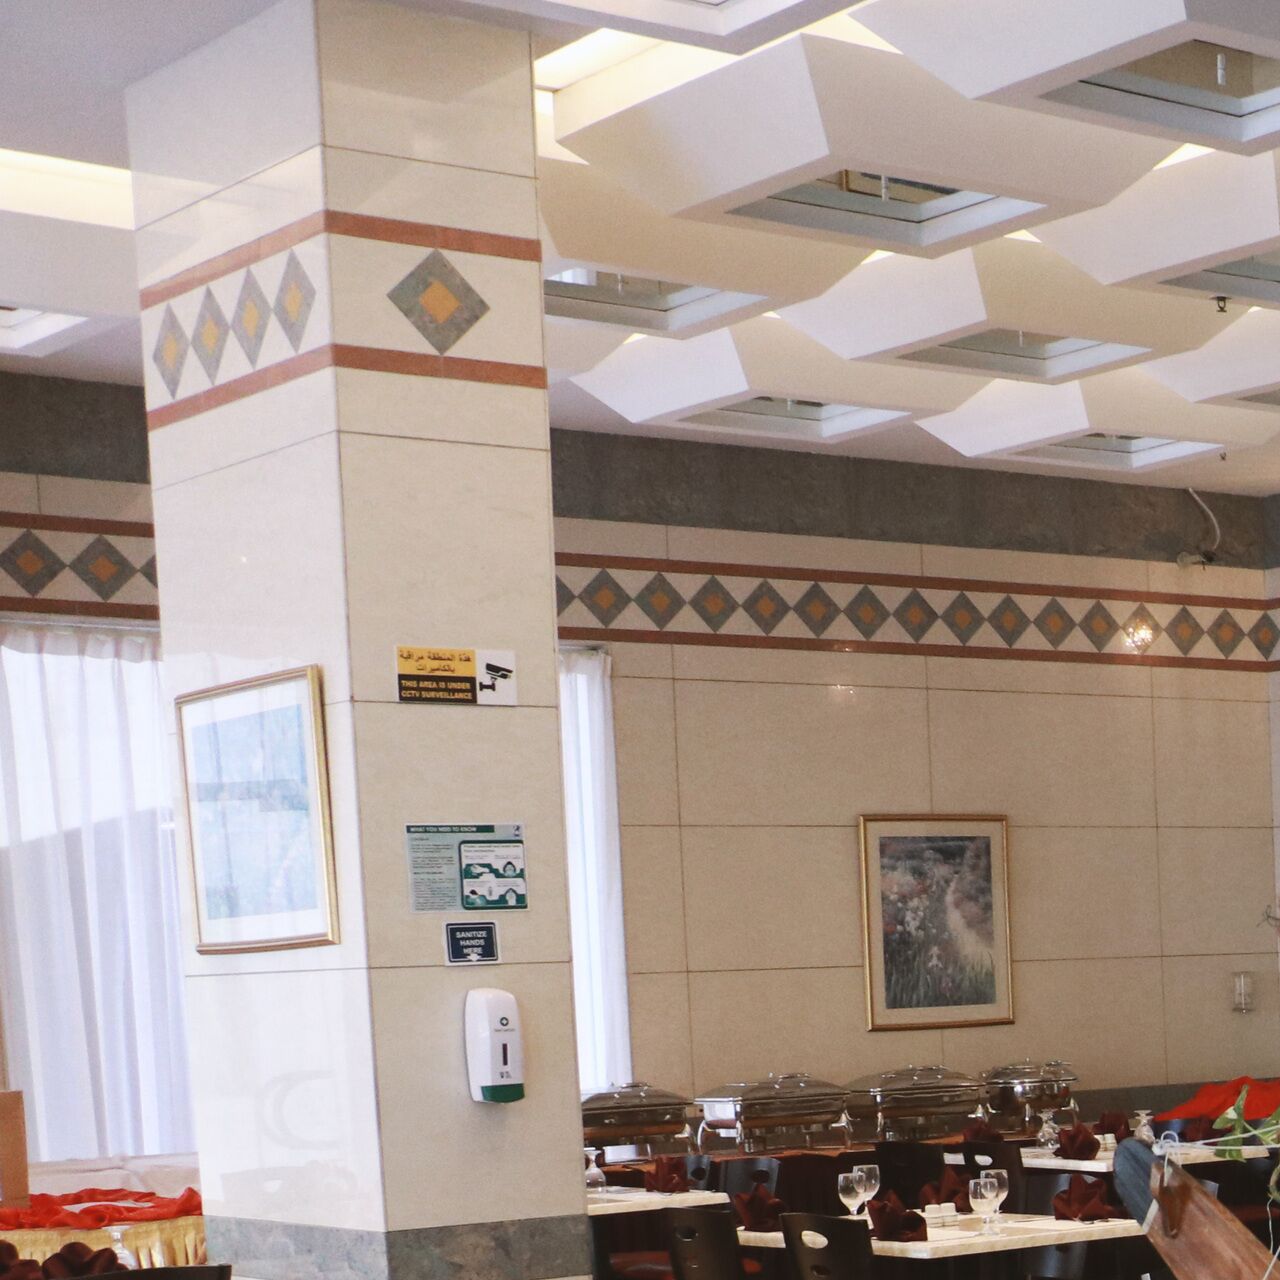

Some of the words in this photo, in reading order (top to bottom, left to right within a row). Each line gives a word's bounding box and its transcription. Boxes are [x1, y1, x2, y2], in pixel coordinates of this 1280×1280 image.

[401, 680, 417, 688] THIS
[420, 681, 437, 689] AREA
[447, 682, 471, 690] UNDER
[401, 690, 420, 698] CCTV
[421, 691, 472, 699] SURVEILLANCE
[456, 930, 487, 938] SANITIZE
